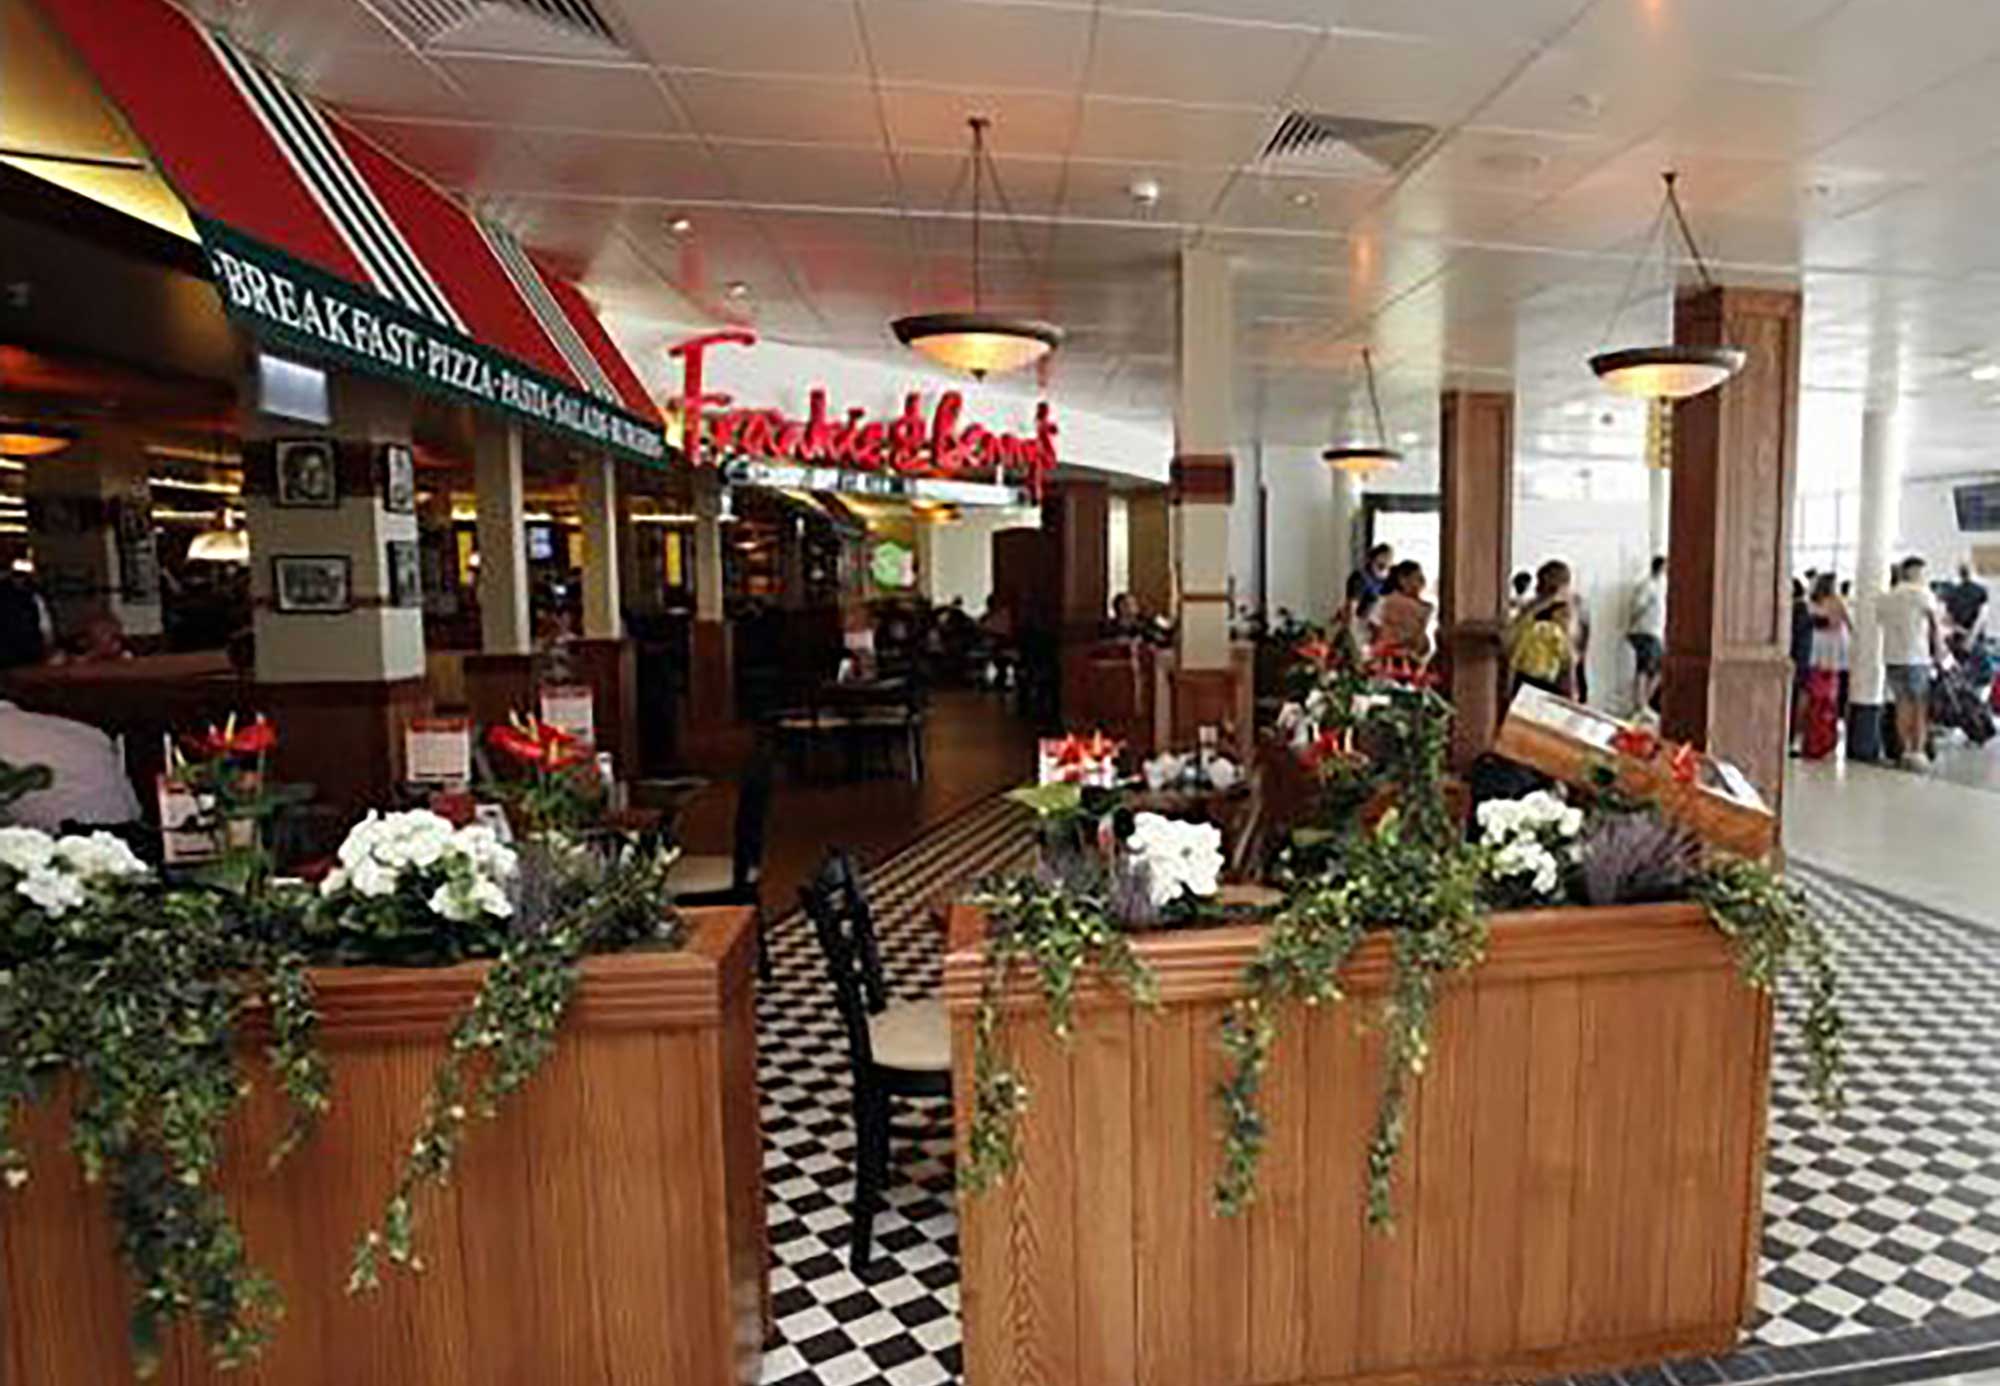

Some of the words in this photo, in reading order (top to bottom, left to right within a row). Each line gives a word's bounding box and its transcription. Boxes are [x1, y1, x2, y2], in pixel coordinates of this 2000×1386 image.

[213, 249, 420, 370] BREAKFAST
[427, 337, 496, 401] PIZZA
[668, 332, 884, 470] Frankie
